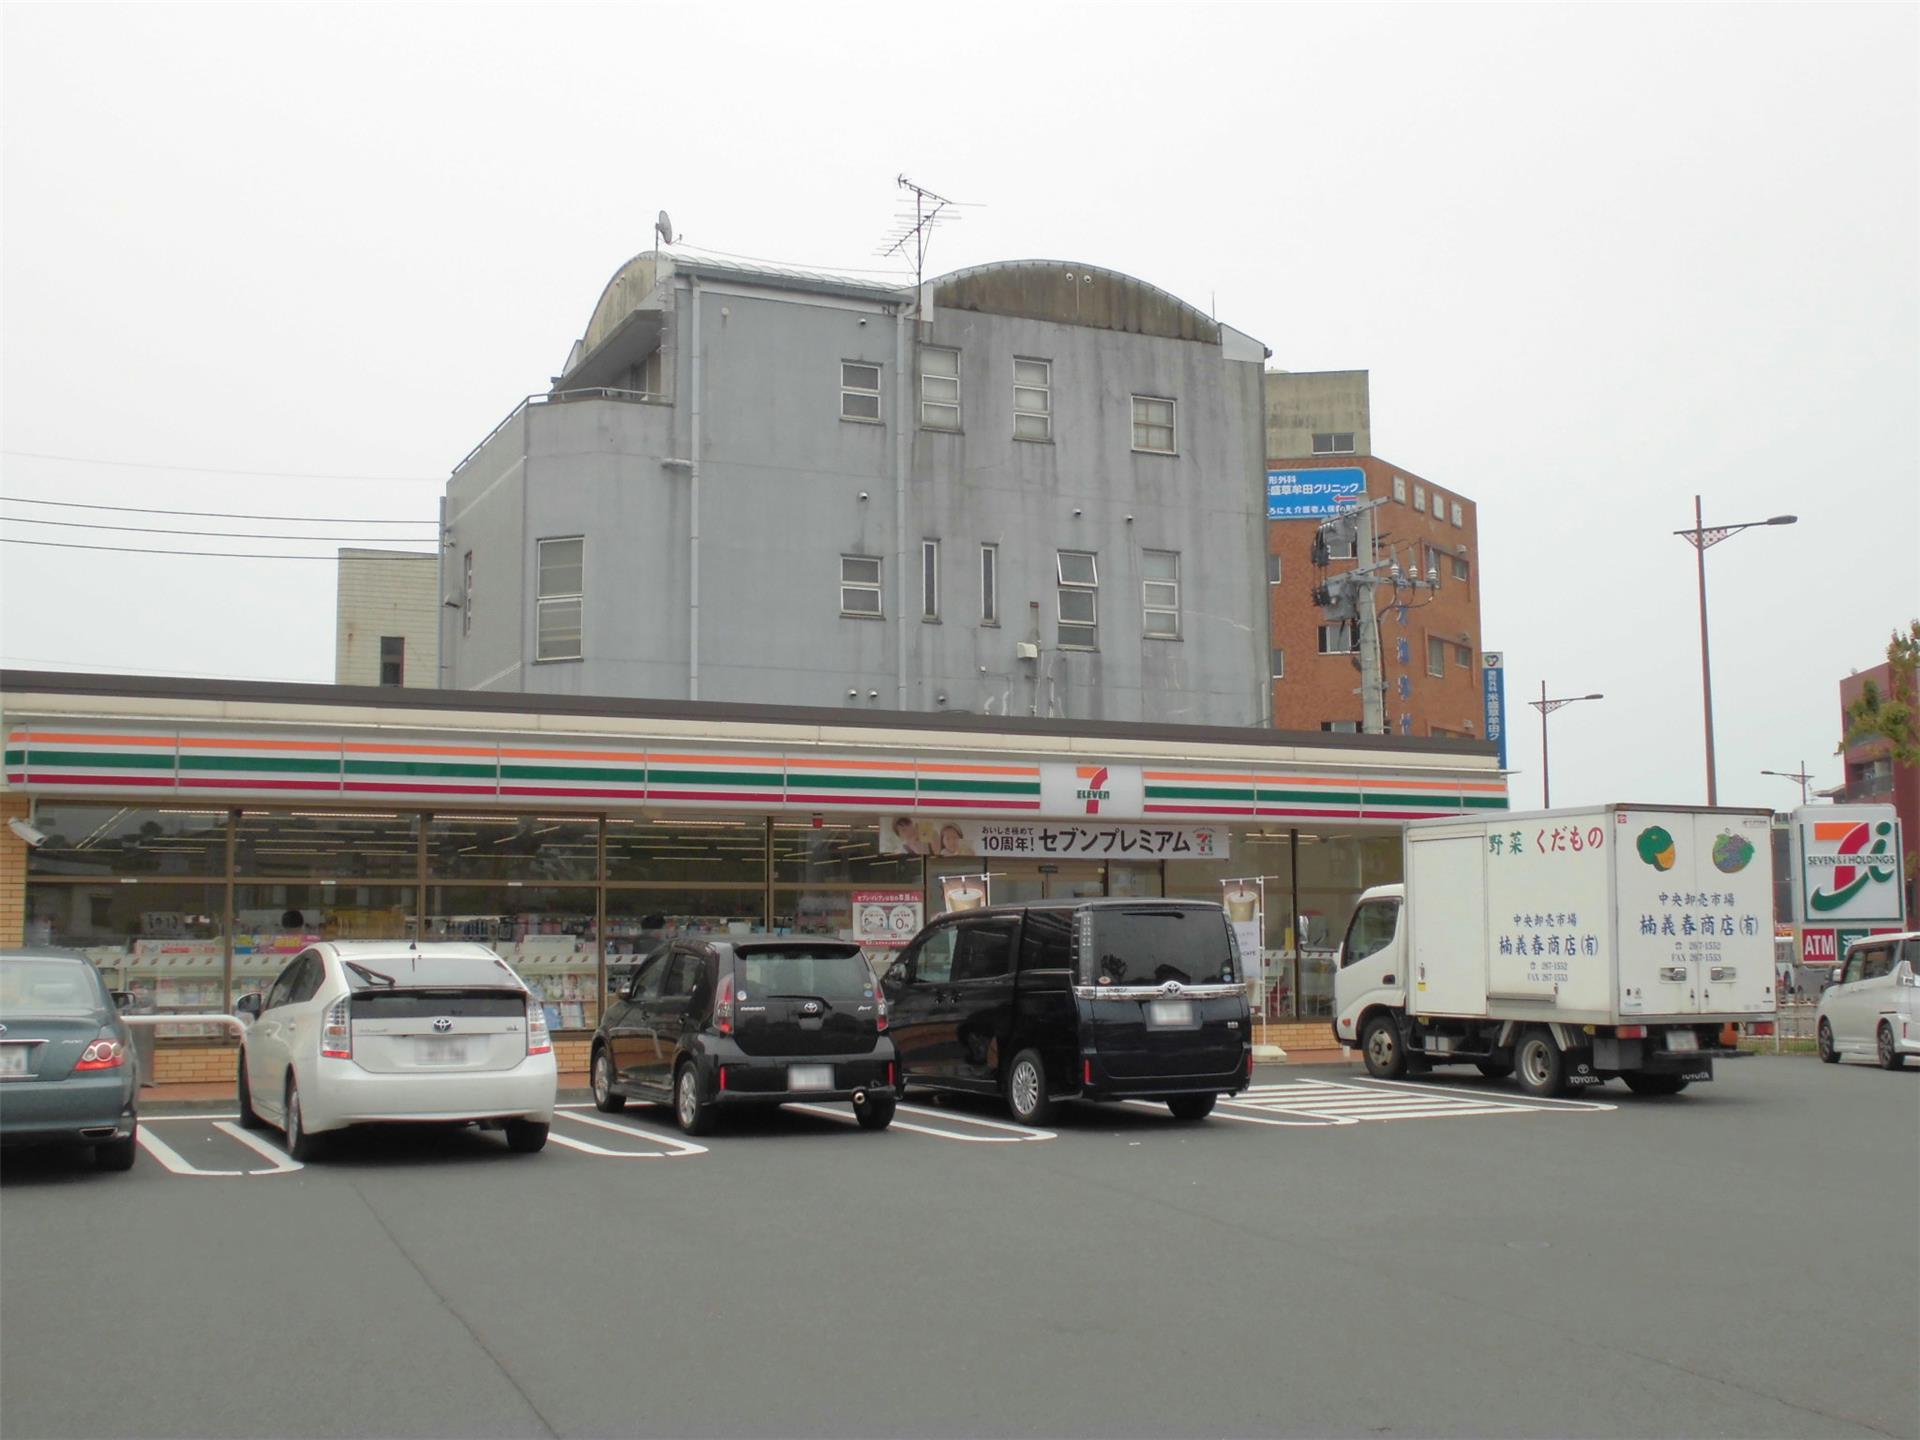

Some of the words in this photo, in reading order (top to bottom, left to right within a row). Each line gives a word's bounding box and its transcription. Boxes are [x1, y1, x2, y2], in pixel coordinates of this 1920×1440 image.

[1267, 483, 1359, 496] 盛草牟田クリニック
[1267, 506, 1292, 515] ろにえ
[1038, 827, 1191, 853] セブンプレミアム
[1488, 830, 1524, 856] 野菜
[1536, 826, 1604, 854] くだもの
[1849, 855, 1895, 864] HOLDINGS
[1658, 892, 1736, 907] 中央卸売市場
[1513, 913, 1578, 928] 中央卸売市場
[1804, 935, 1834, 956] ATM
[1671, 953, 1686, 962] FAX
[1569, 1076, 1600, 1084] TOYOTA
